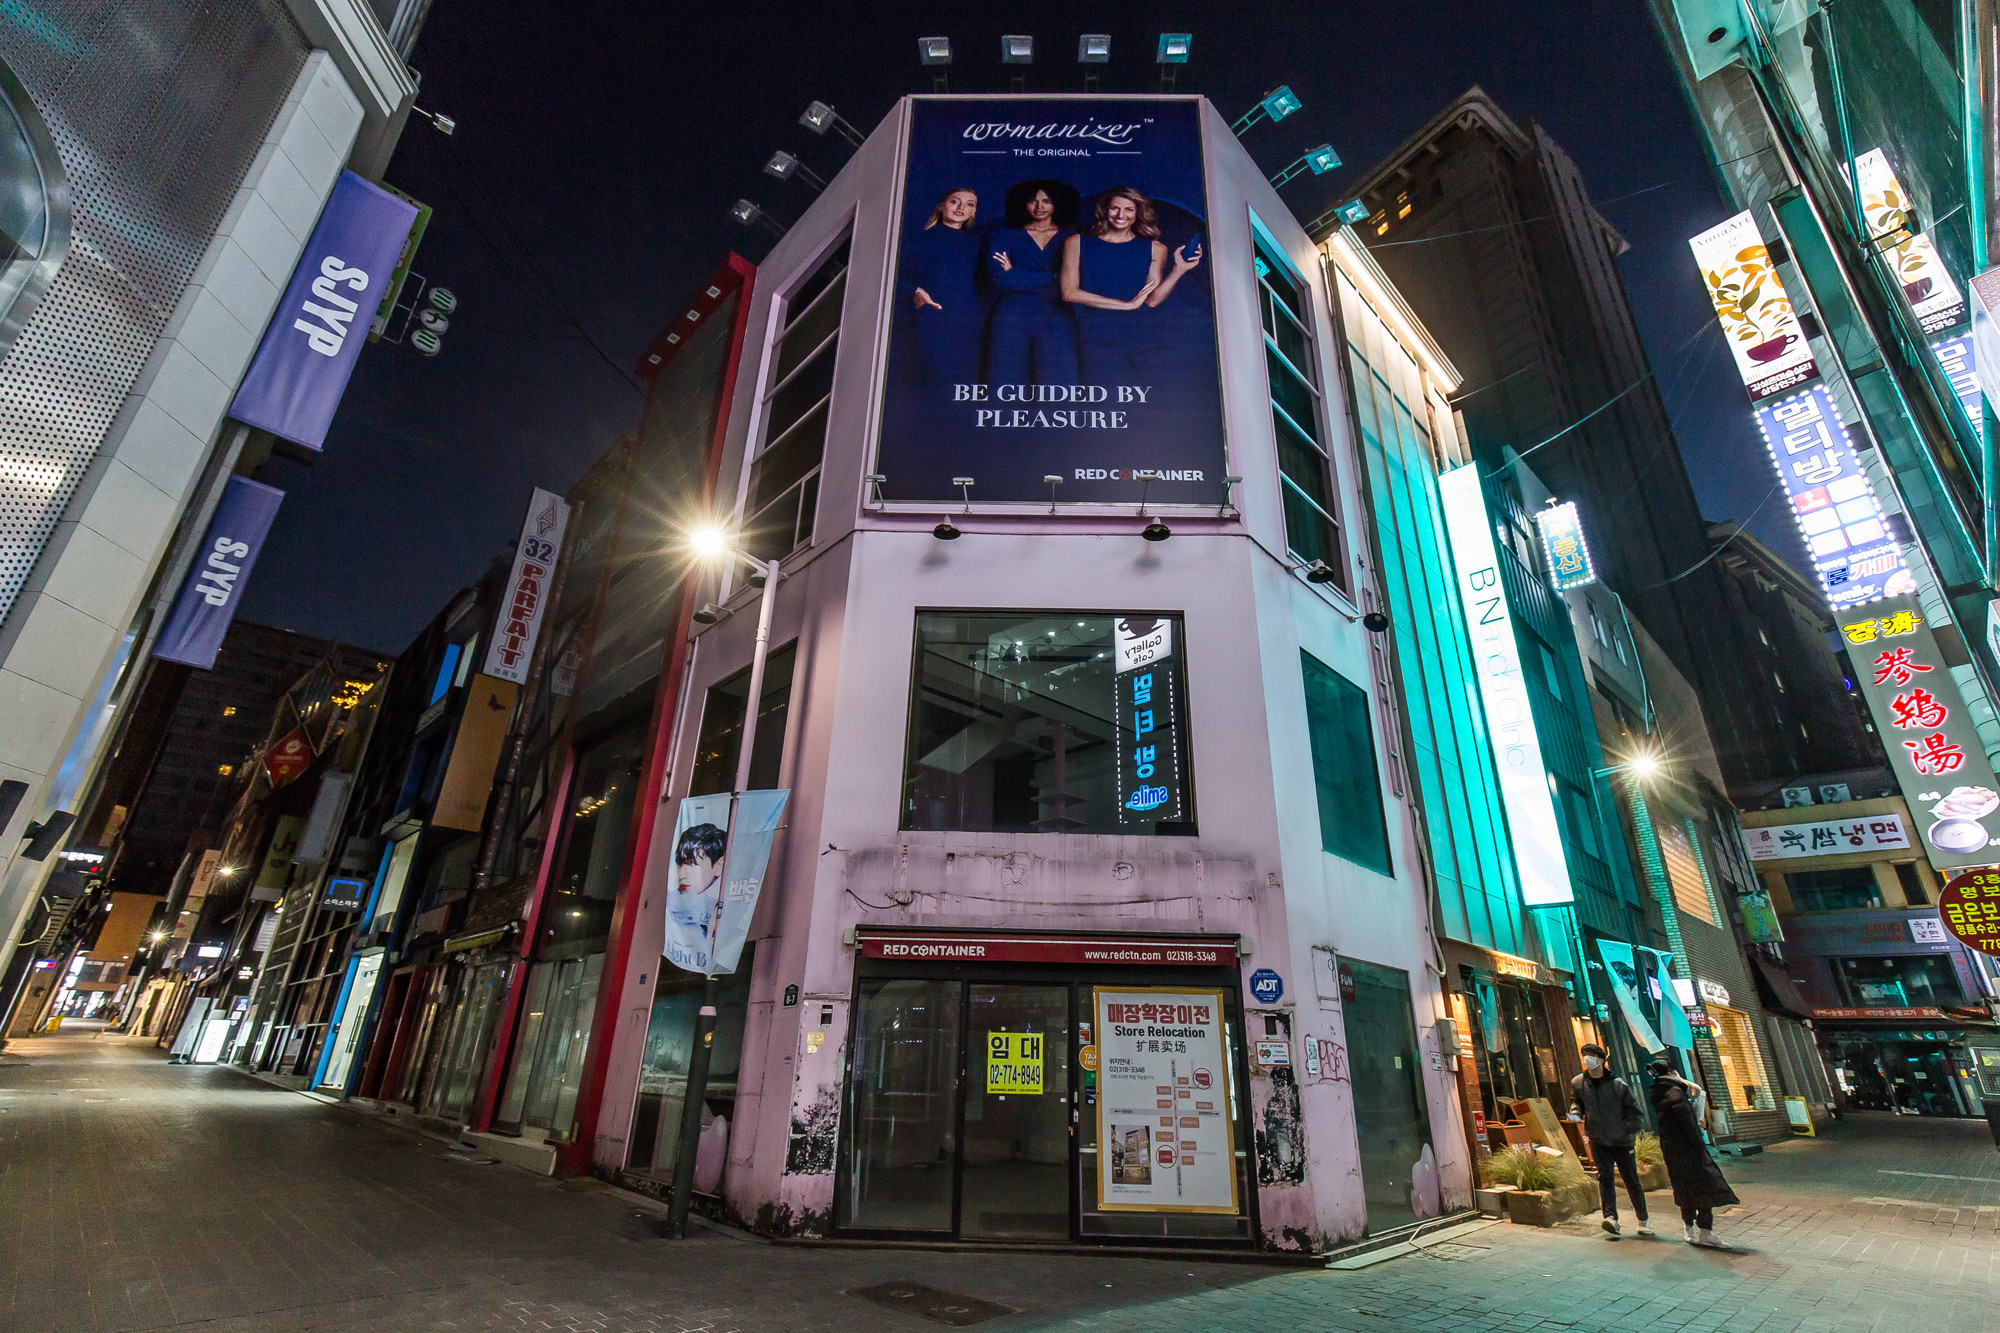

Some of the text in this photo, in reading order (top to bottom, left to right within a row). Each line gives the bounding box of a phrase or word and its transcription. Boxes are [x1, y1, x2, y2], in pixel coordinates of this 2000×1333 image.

[963, 117, 1141, 144] womanizer
[1037, 149, 1091, 157] ORIGINAL
[294, 256, 369, 357] SJYP
[953, 384, 1152, 403] BE GUIDED BY
[975, 409, 1128, 429] PLEASURE
[1772, 394, 1845, 484] 멀티방
[1075, 468, 1107, 481] RED
[524, 536, 555, 565] 32
[195, 537, 249, 606] SJYP
[499, 561, 546, 669] PARFAIT
[1779, 821, 1903, 852] 육쌈냉면
[883, 944, 1217, 962] RED CONTAINER www.redctn.com 02)318-3348
[1256, 979, 1277, 992] ADT
[1340, 974, 1353, 986] FUN
[1107, 1003, 1210, 1025] 매장확장이전
[1115, 1025, 1205, 1038] Store Relocation
[1136, 1039, 1187, 1053] 扩展卖场
[990, 1064, 1040, 1085] 02-774-8949
